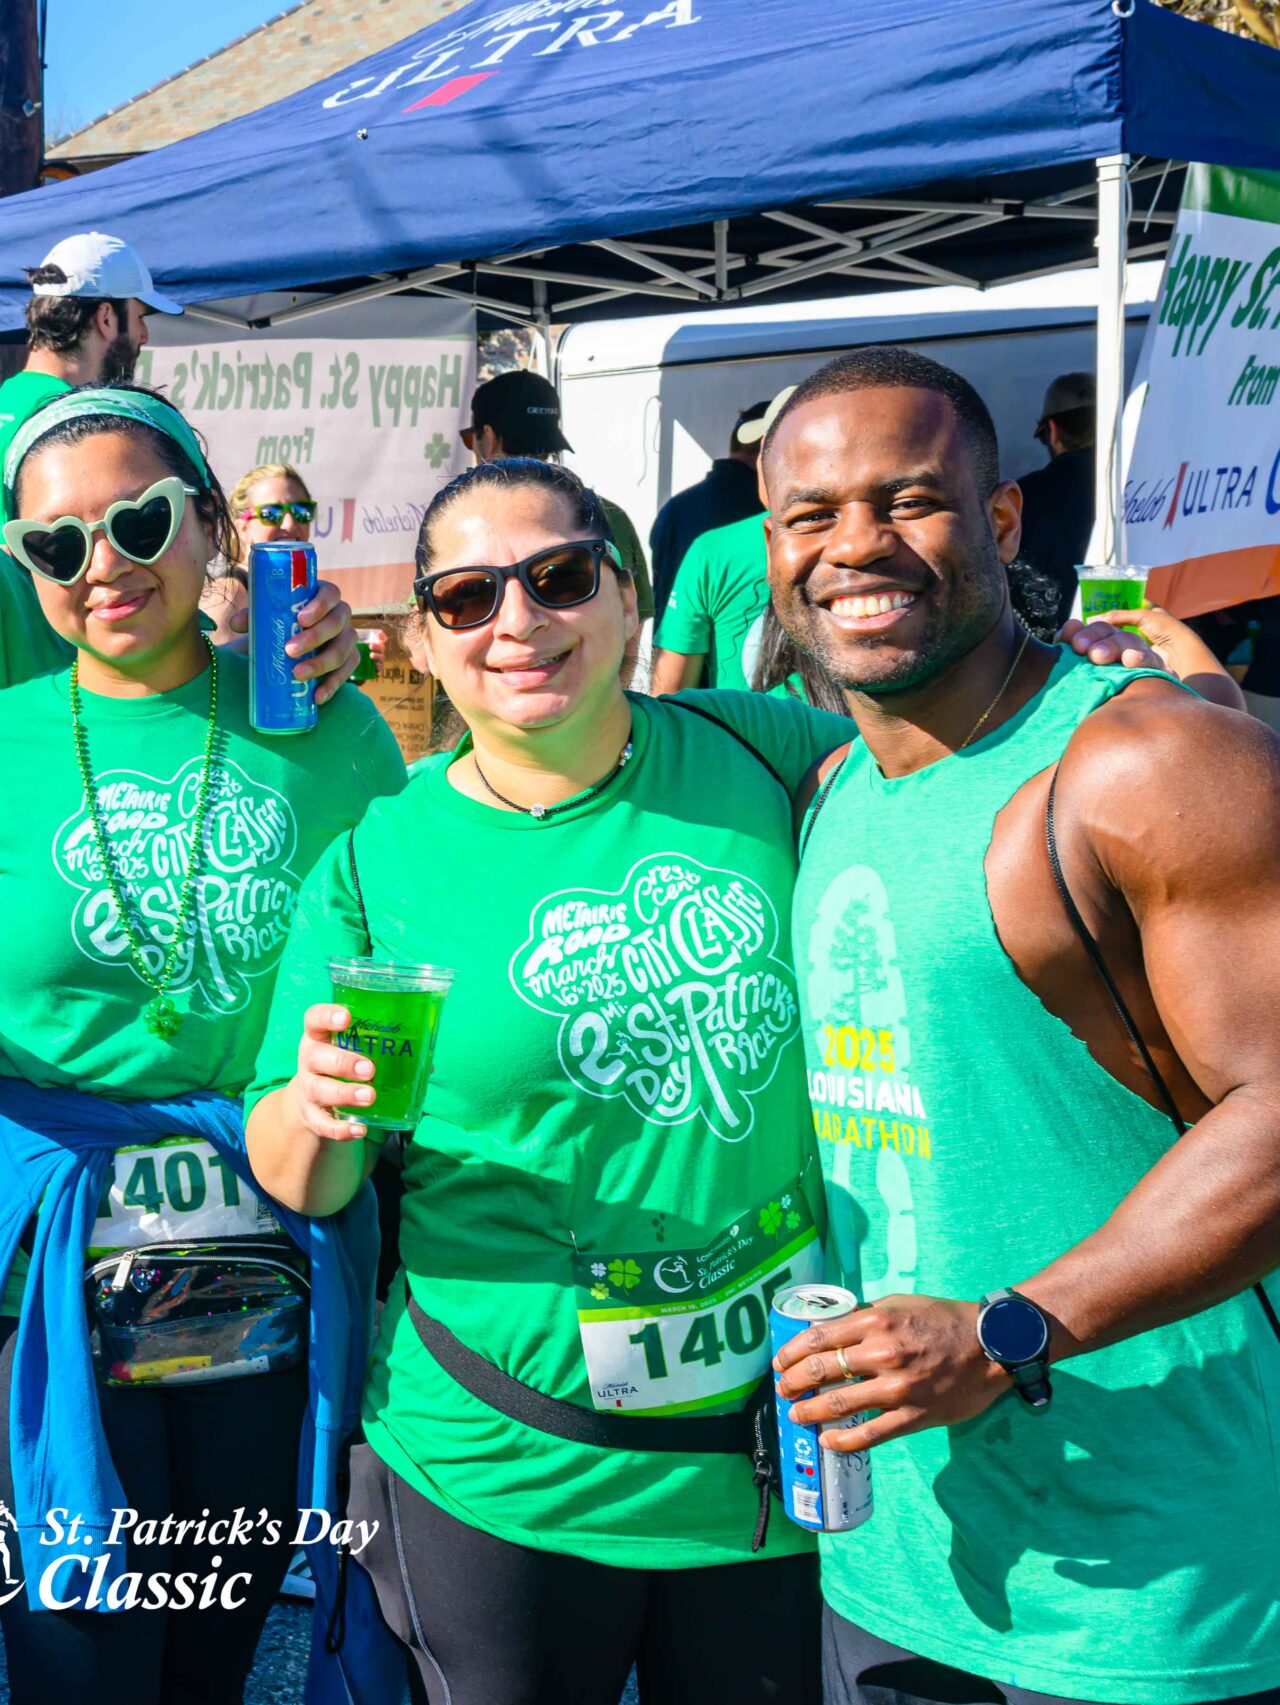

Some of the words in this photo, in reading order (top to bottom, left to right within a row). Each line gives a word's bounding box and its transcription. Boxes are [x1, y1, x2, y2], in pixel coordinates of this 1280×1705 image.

[1159, 233, 1252, 357] Happy
[1228, 355, 1280, 405] From
[1182, 465, 1258, 517] ULTRA
[83, 889, 130, 956] 2
[584, 973, 627, 1002] 2025
[337, 1031, 414, 1057] ULTRA
[570, 1011, 626, 1085] 2
[707, 1023, 776, 1075] RACE
[823, 1024, 896, 1073] 2025
[625, 1056, 690, 1116] Day
[597, 1386, 639, 1398] ULTRA
